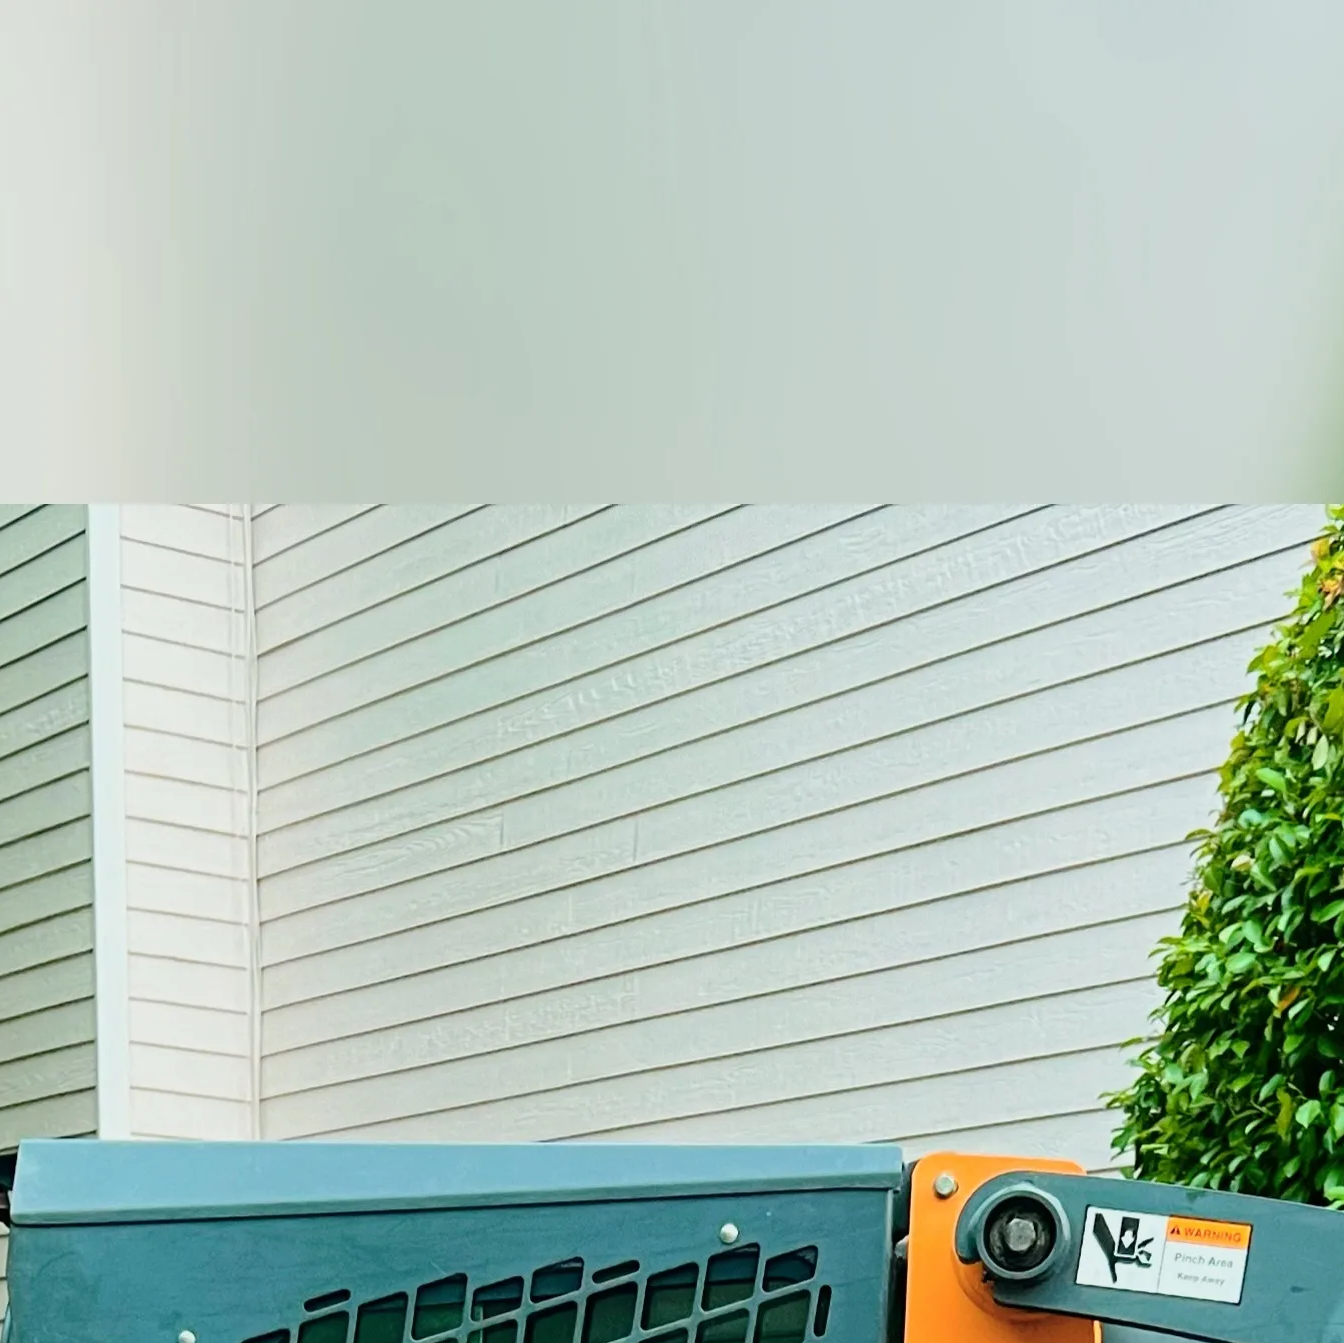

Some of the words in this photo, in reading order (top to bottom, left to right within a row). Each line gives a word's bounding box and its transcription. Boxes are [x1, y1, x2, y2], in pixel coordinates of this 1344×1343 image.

[1184, 1228, 1241, 1243] WARNING
[1175, 1253, 1205, 1266] Pinch
[1209, 1257, 1233, 1268] Area
